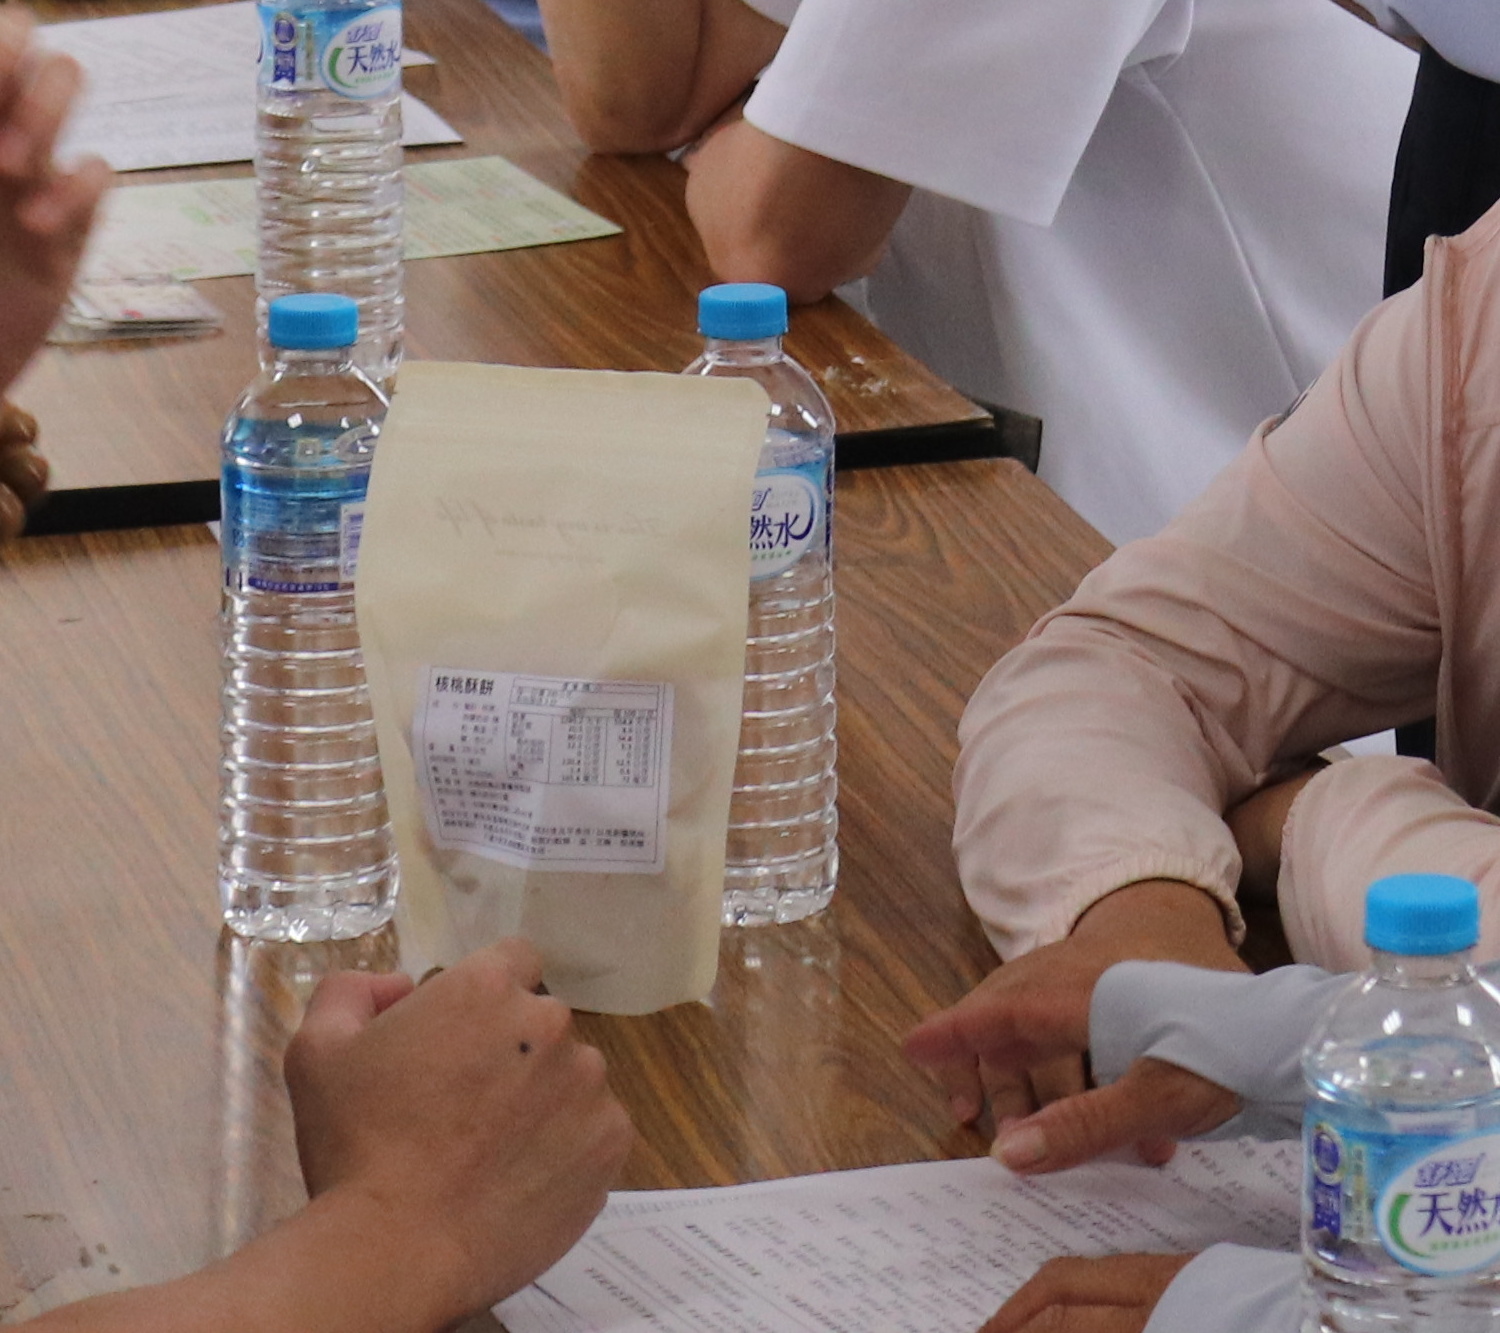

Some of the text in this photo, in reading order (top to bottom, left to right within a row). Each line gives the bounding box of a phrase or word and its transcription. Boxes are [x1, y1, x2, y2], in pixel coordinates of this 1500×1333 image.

[347, 39, 401, 75] 天然水
[750, 511, 814, 549] 然水
[435, 675, 495, 696] 核桃酥餅
